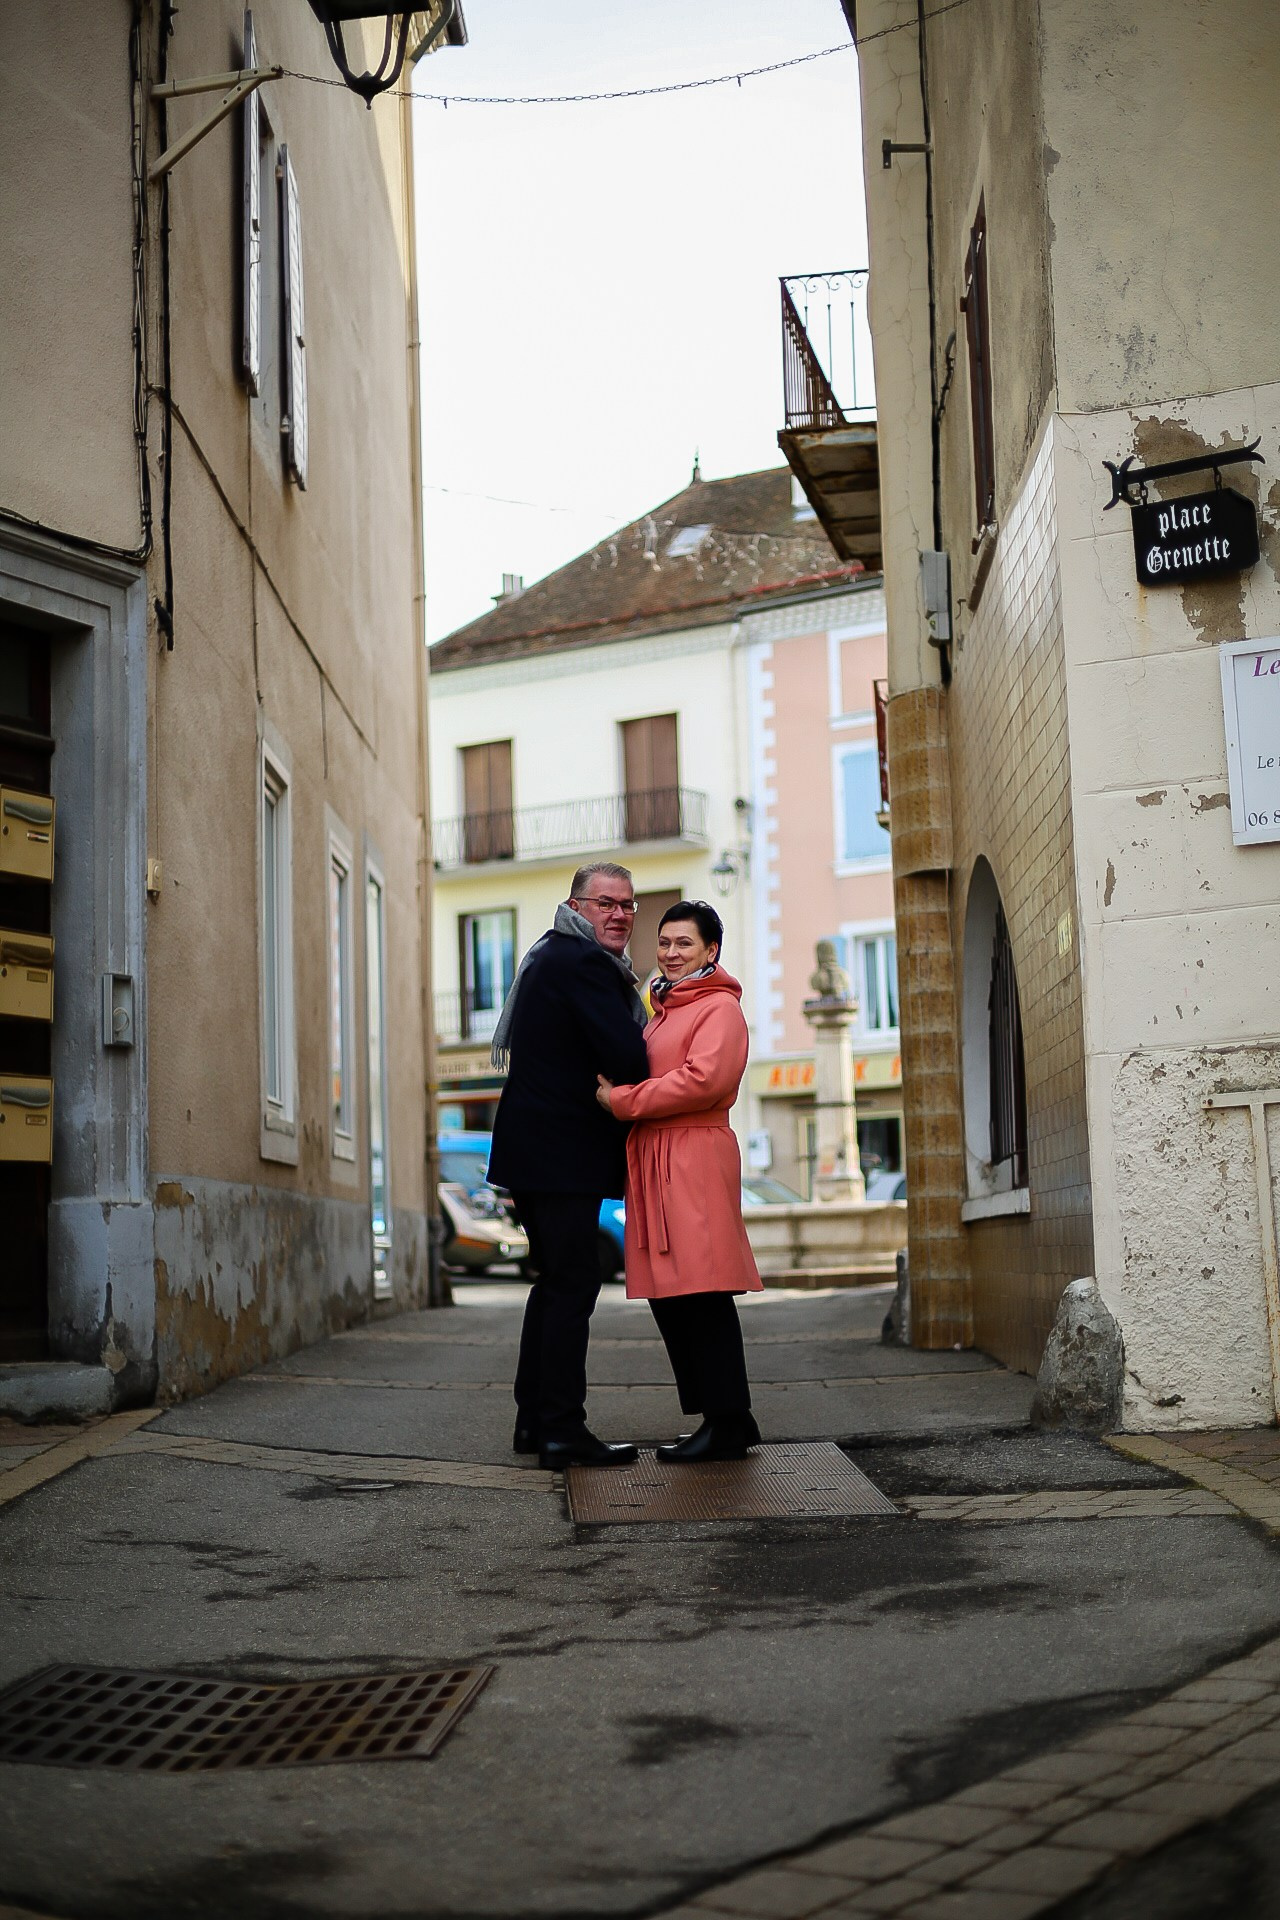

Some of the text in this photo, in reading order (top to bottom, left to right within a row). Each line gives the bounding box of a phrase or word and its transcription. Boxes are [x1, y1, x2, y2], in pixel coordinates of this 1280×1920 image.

[1159, 504, 1212, 538] place
[1146, 536, 1231, 574] Grenette
[1252, 655, 1280, 677] Le
[1257, 755, 1275, 769] Le
[1248, 811, 1268, 827] 06
